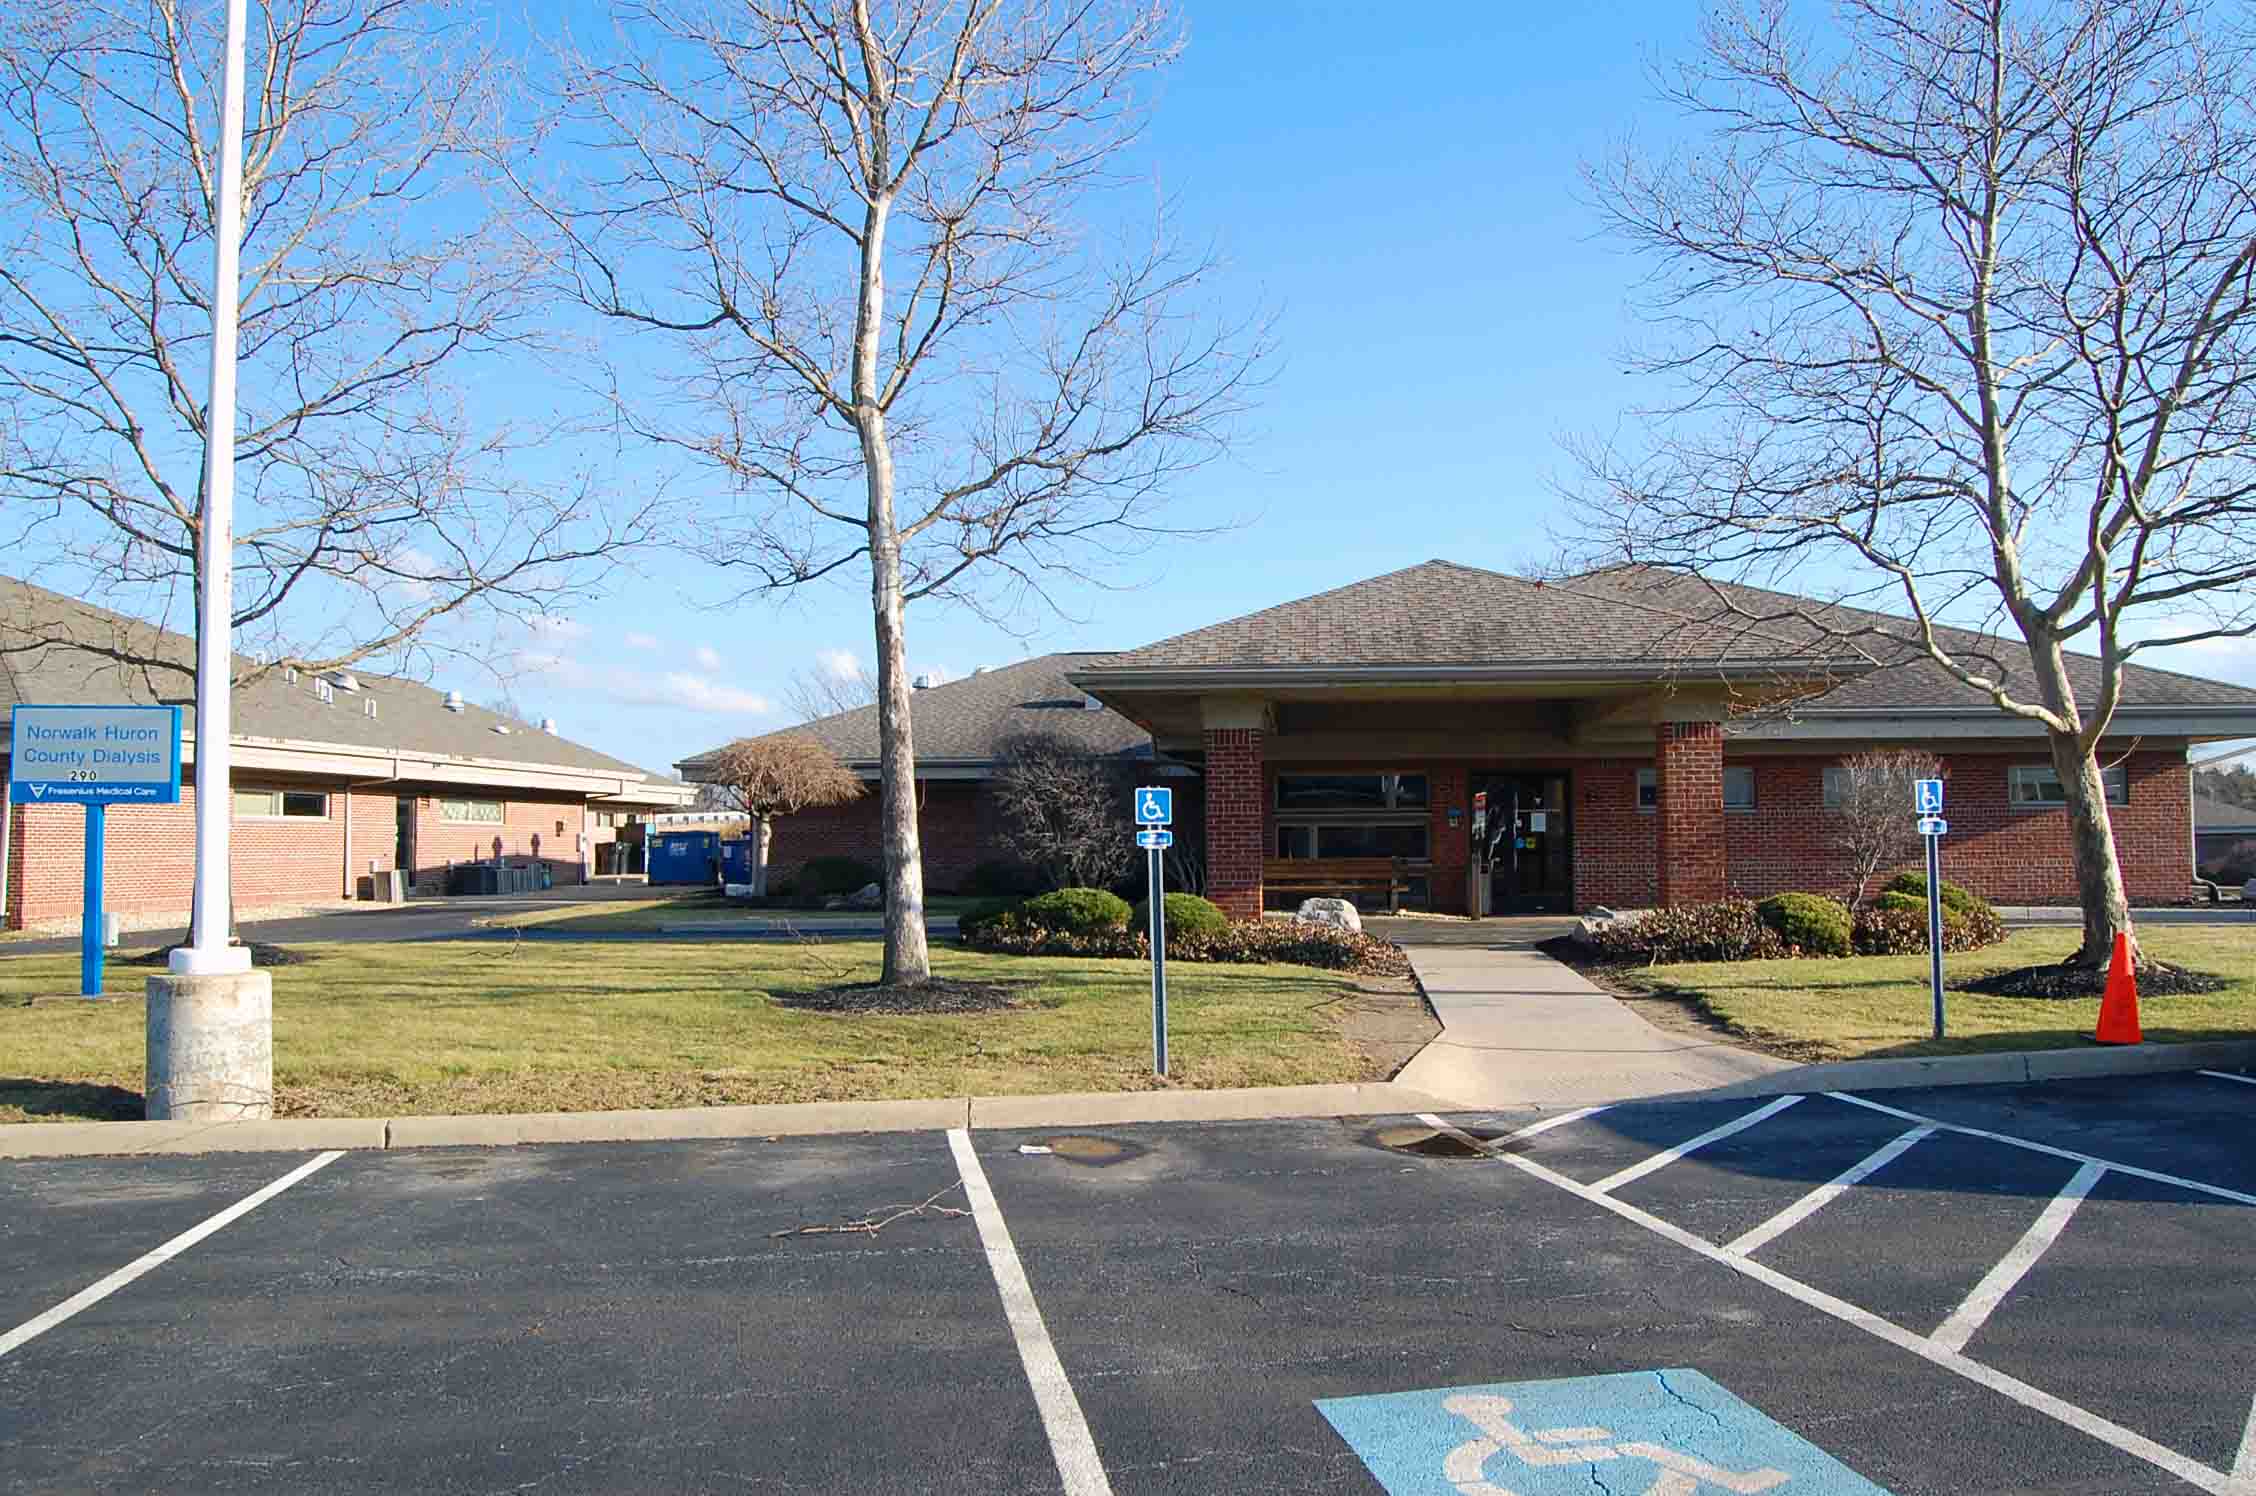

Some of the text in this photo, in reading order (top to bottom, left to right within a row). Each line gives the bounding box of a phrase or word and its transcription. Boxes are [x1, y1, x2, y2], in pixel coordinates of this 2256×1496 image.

[27, 725, 158, 741] Norwalk Huron
[24, 748, 161, 765] County Dialysis
[71, 770, 97, 781] 290
[96, 786, 132, 796] Medical
[133, 787, 157, 796] Care
